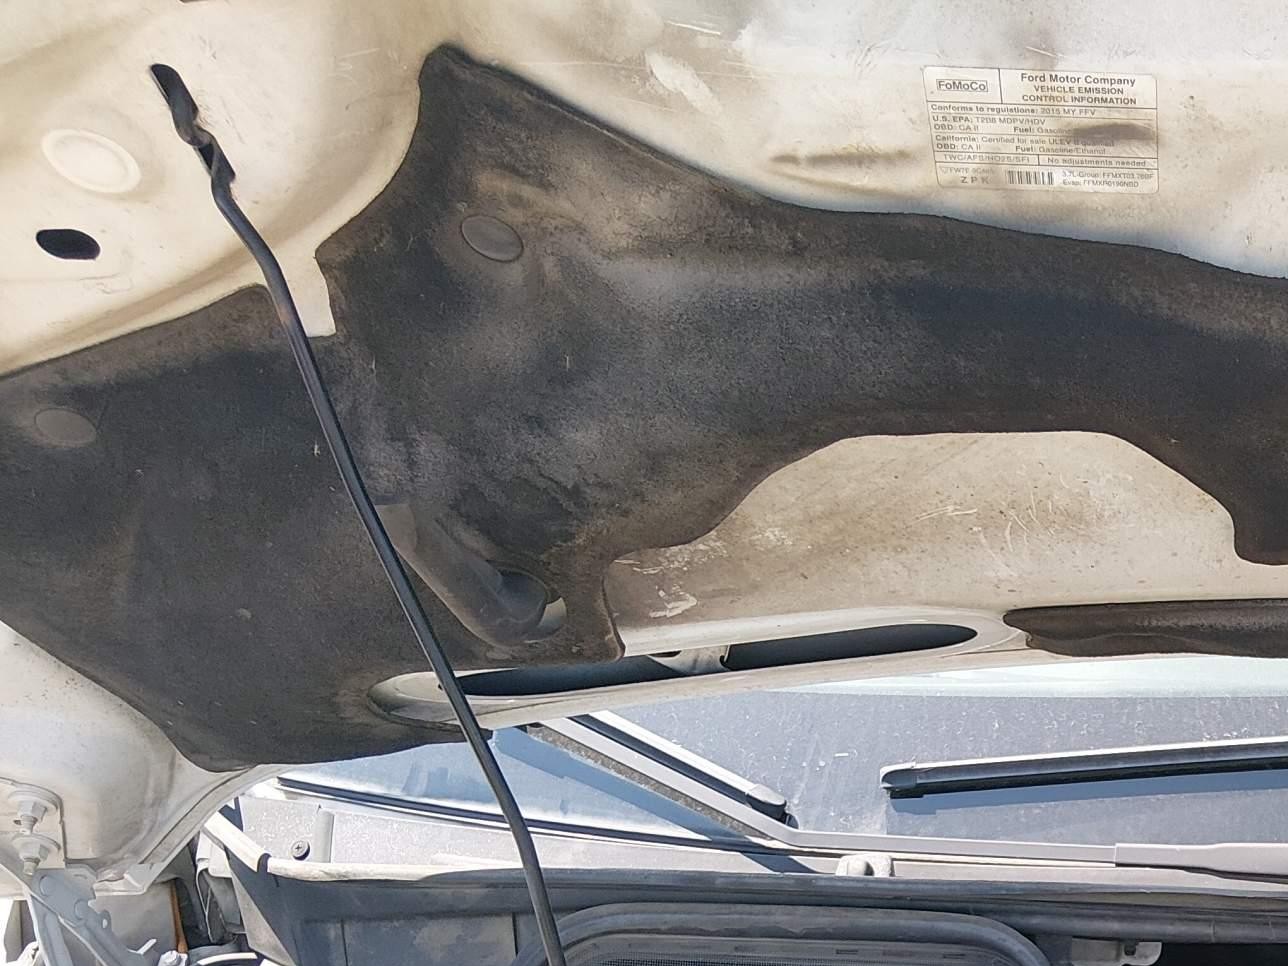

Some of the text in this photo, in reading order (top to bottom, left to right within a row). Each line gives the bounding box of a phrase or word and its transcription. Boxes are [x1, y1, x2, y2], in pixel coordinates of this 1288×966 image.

[1021, 72, 1136, 87] Ford Motor Company
[937, 80, 987, 92] FoMoCo
[1034, 85, 1124, 95] VEHICLE EMISSION
[1022, 95, 1137, 105] CONTROL INFORMATION
[930, 103, 974, 112] Conforms
[987, 106, 1038, 115] regulations:
[1116, 160, 1146, 168] needed
